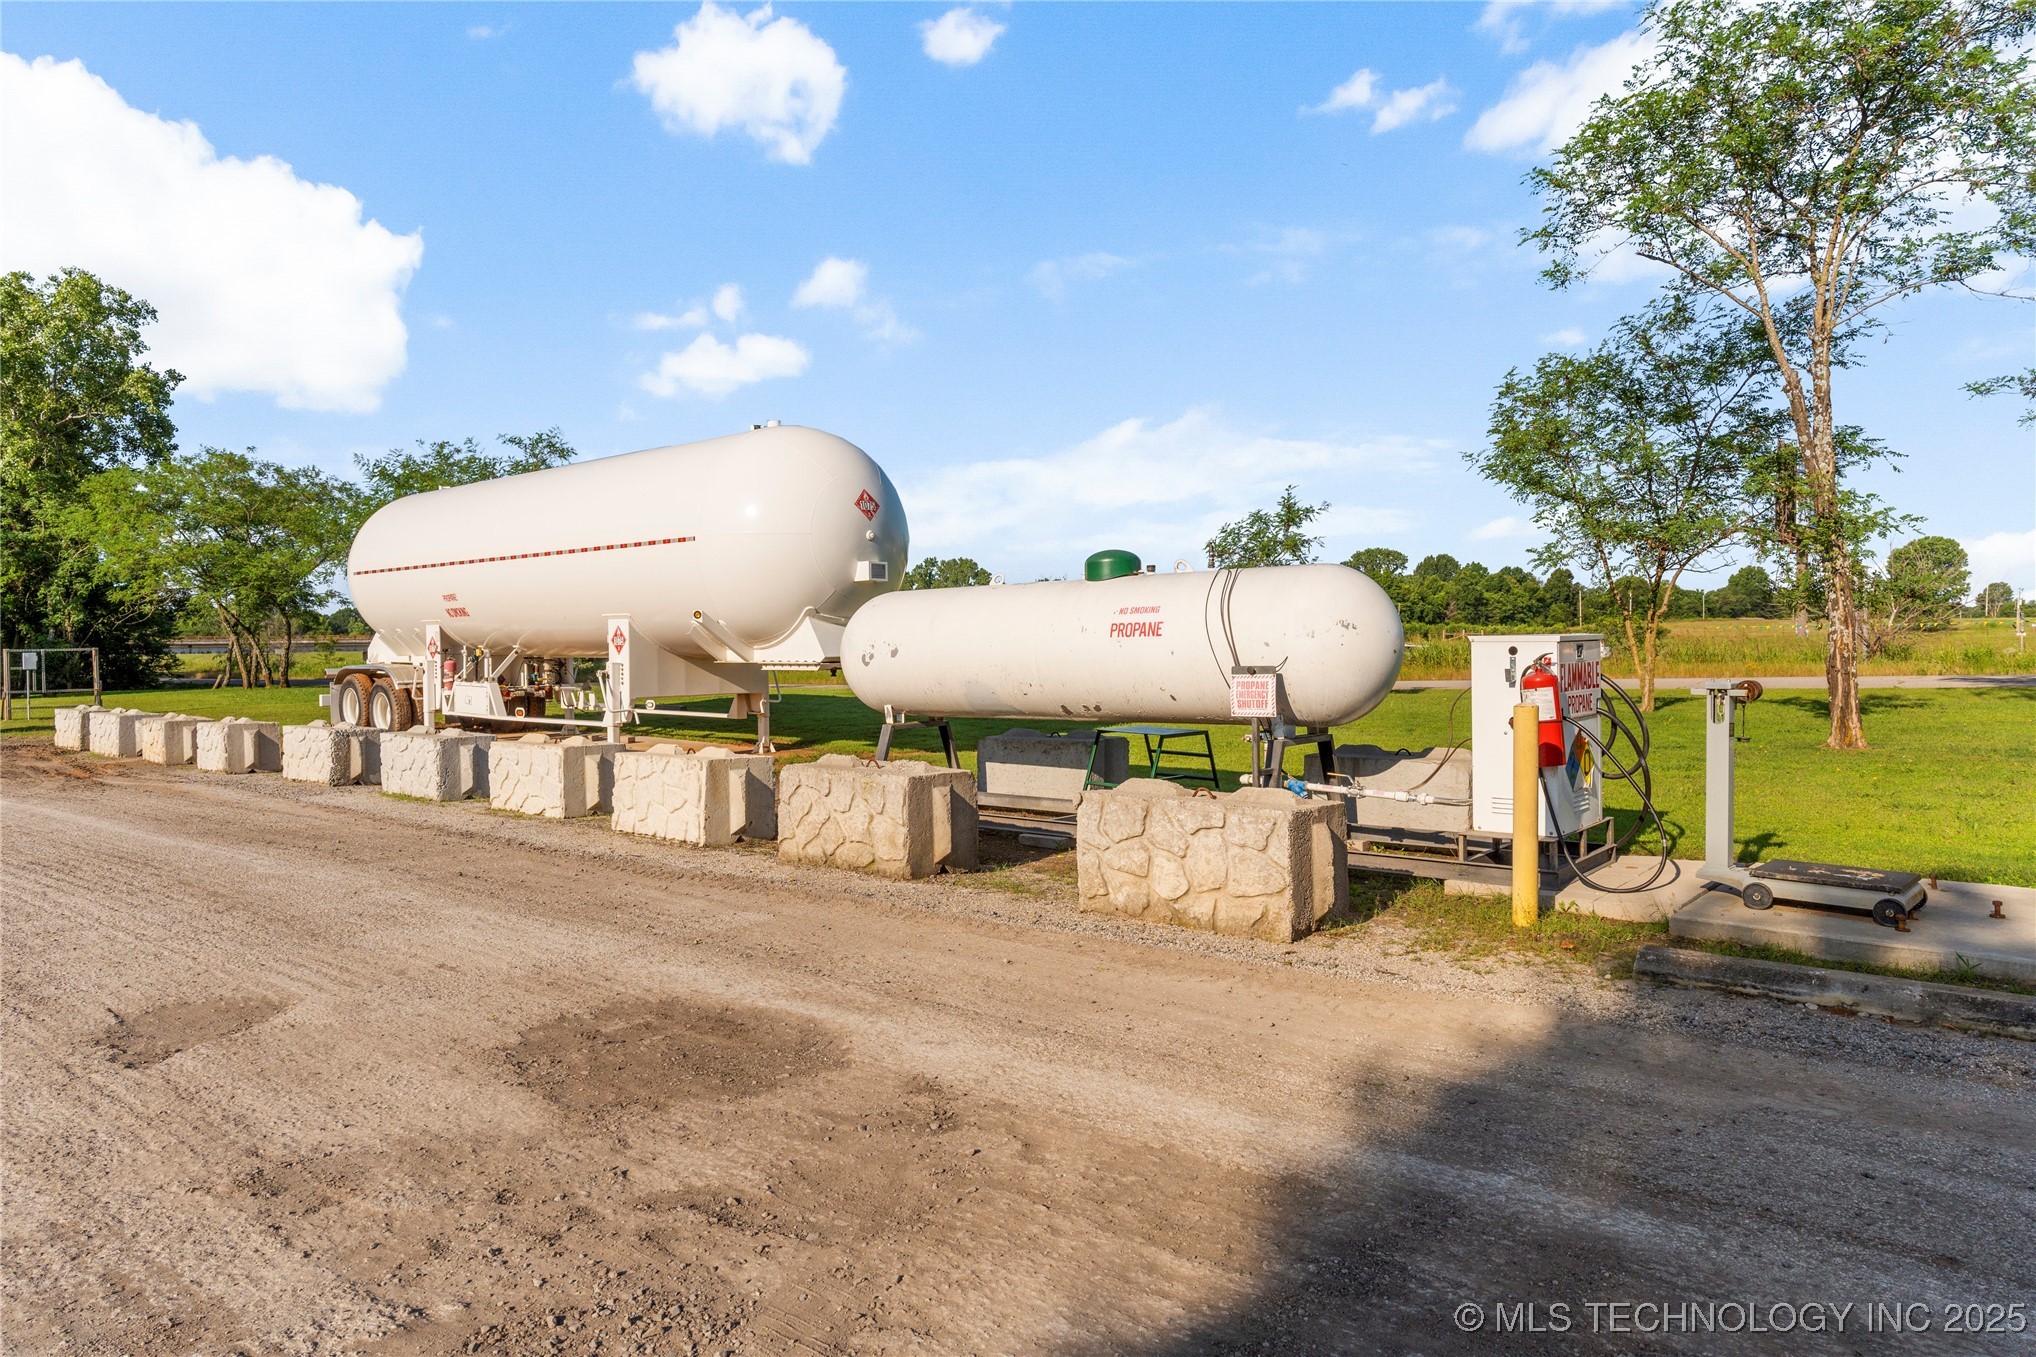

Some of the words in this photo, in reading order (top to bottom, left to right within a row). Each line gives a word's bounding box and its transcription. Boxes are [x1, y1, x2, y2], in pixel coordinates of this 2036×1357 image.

[1118, 607, 1129, 615] NO
[1129, 605, 1161, 615] SMOKING
[1109, 621, 1164, 638] PROPANE
[1560, 661, 1600, 693] FLAMMABLE
[1236, 680, 1269, 690] PROPANE
[1236, 690, 1269, 699] EMERGENCY
[1237, 699, 1269, 709] SHUTOFF
[1567, 692, 1593, 714] PROPANE
